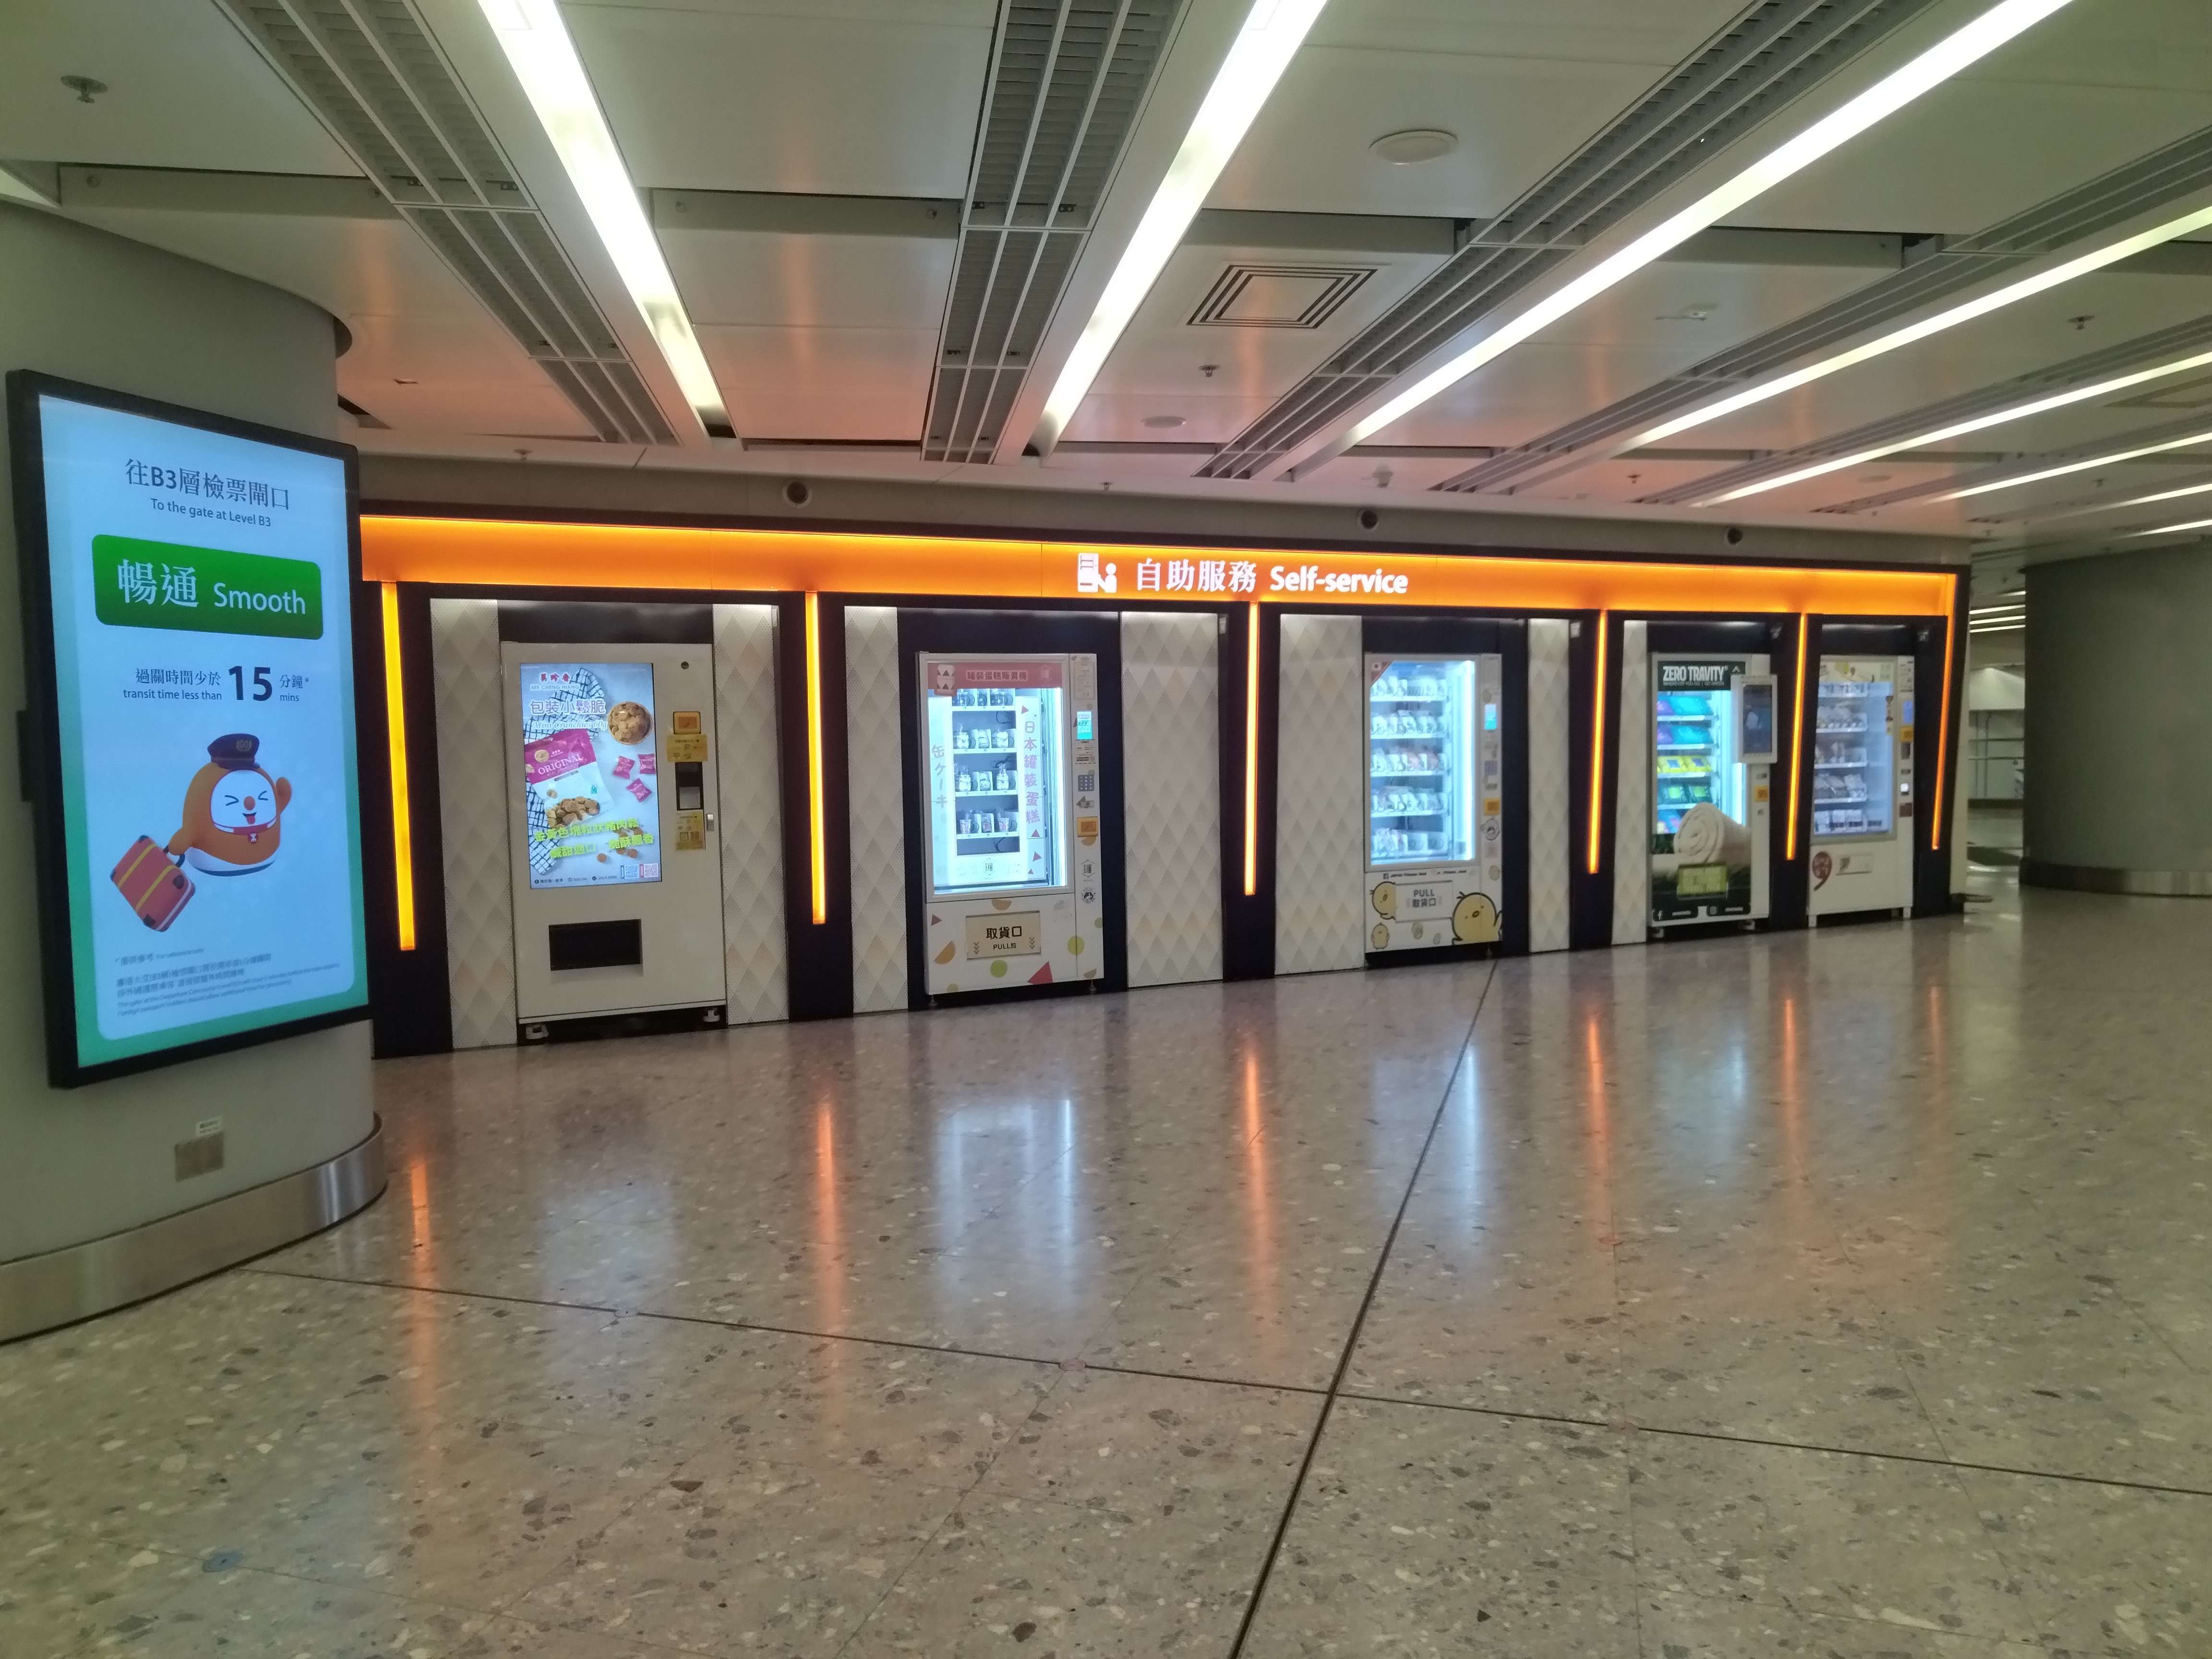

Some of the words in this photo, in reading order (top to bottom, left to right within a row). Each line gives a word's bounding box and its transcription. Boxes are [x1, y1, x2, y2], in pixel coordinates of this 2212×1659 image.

[125, 458, 289, 510] 往B3層檢票閘口
[150, 498, 164, 510] To
[167, 501, 186, 514] the
[189, 507, 213, 518] gate
[216, 510, 226, 520] at
[229, 511, 256, 524] Level
[259, 516, 271, 527] B3
[118, 559, 199, 607] 暢通
[214, 582, 306, 614] Smooth
[1136, 558, 1257, 592] 自助服務
[1270, 565, 1408, 594] Self-service
[135, 668, 221, 685] 過關時間少於
[228, 666, 272, 701] 15
[1663, 665, 1687, 682] ZERO
[123, 689, 156, 698] transit
[158, 689, 180, 699] time
[182, 690, 199, 699] less
[202, 690, 222, 700] than
[280, 693, 300, 701] mins
[538, 754, 584, 775] ORIGINAL
[1413, 889, 1435, 898] PULL
[986, 926, 1022, 940] 取貨口
